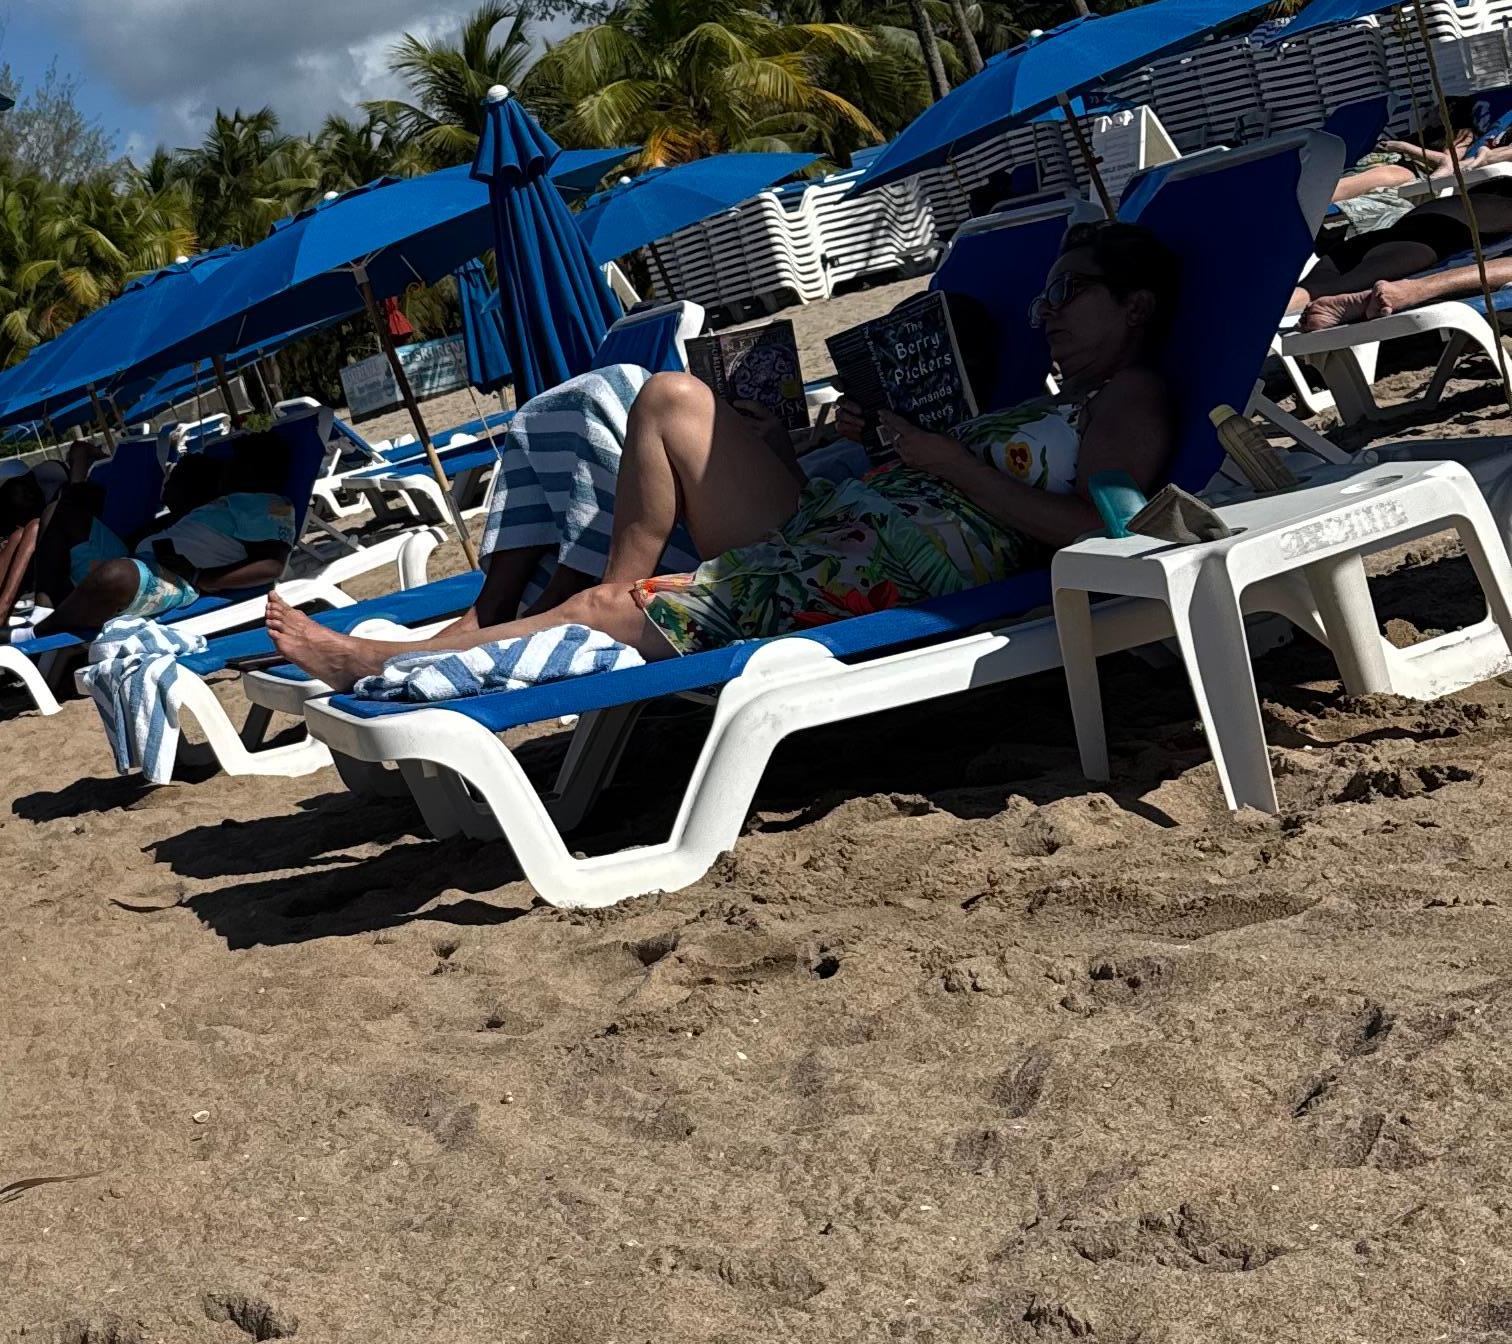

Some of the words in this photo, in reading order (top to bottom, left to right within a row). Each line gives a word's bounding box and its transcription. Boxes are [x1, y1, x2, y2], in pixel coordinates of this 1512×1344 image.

[903, 320, 923, 335] The
[894, 332, 940, 360] Berry
[894, 353, 952, 385] Pickers
[911, 385, 953, 408] Amanda
[918, 405, 954, 424] Peters
